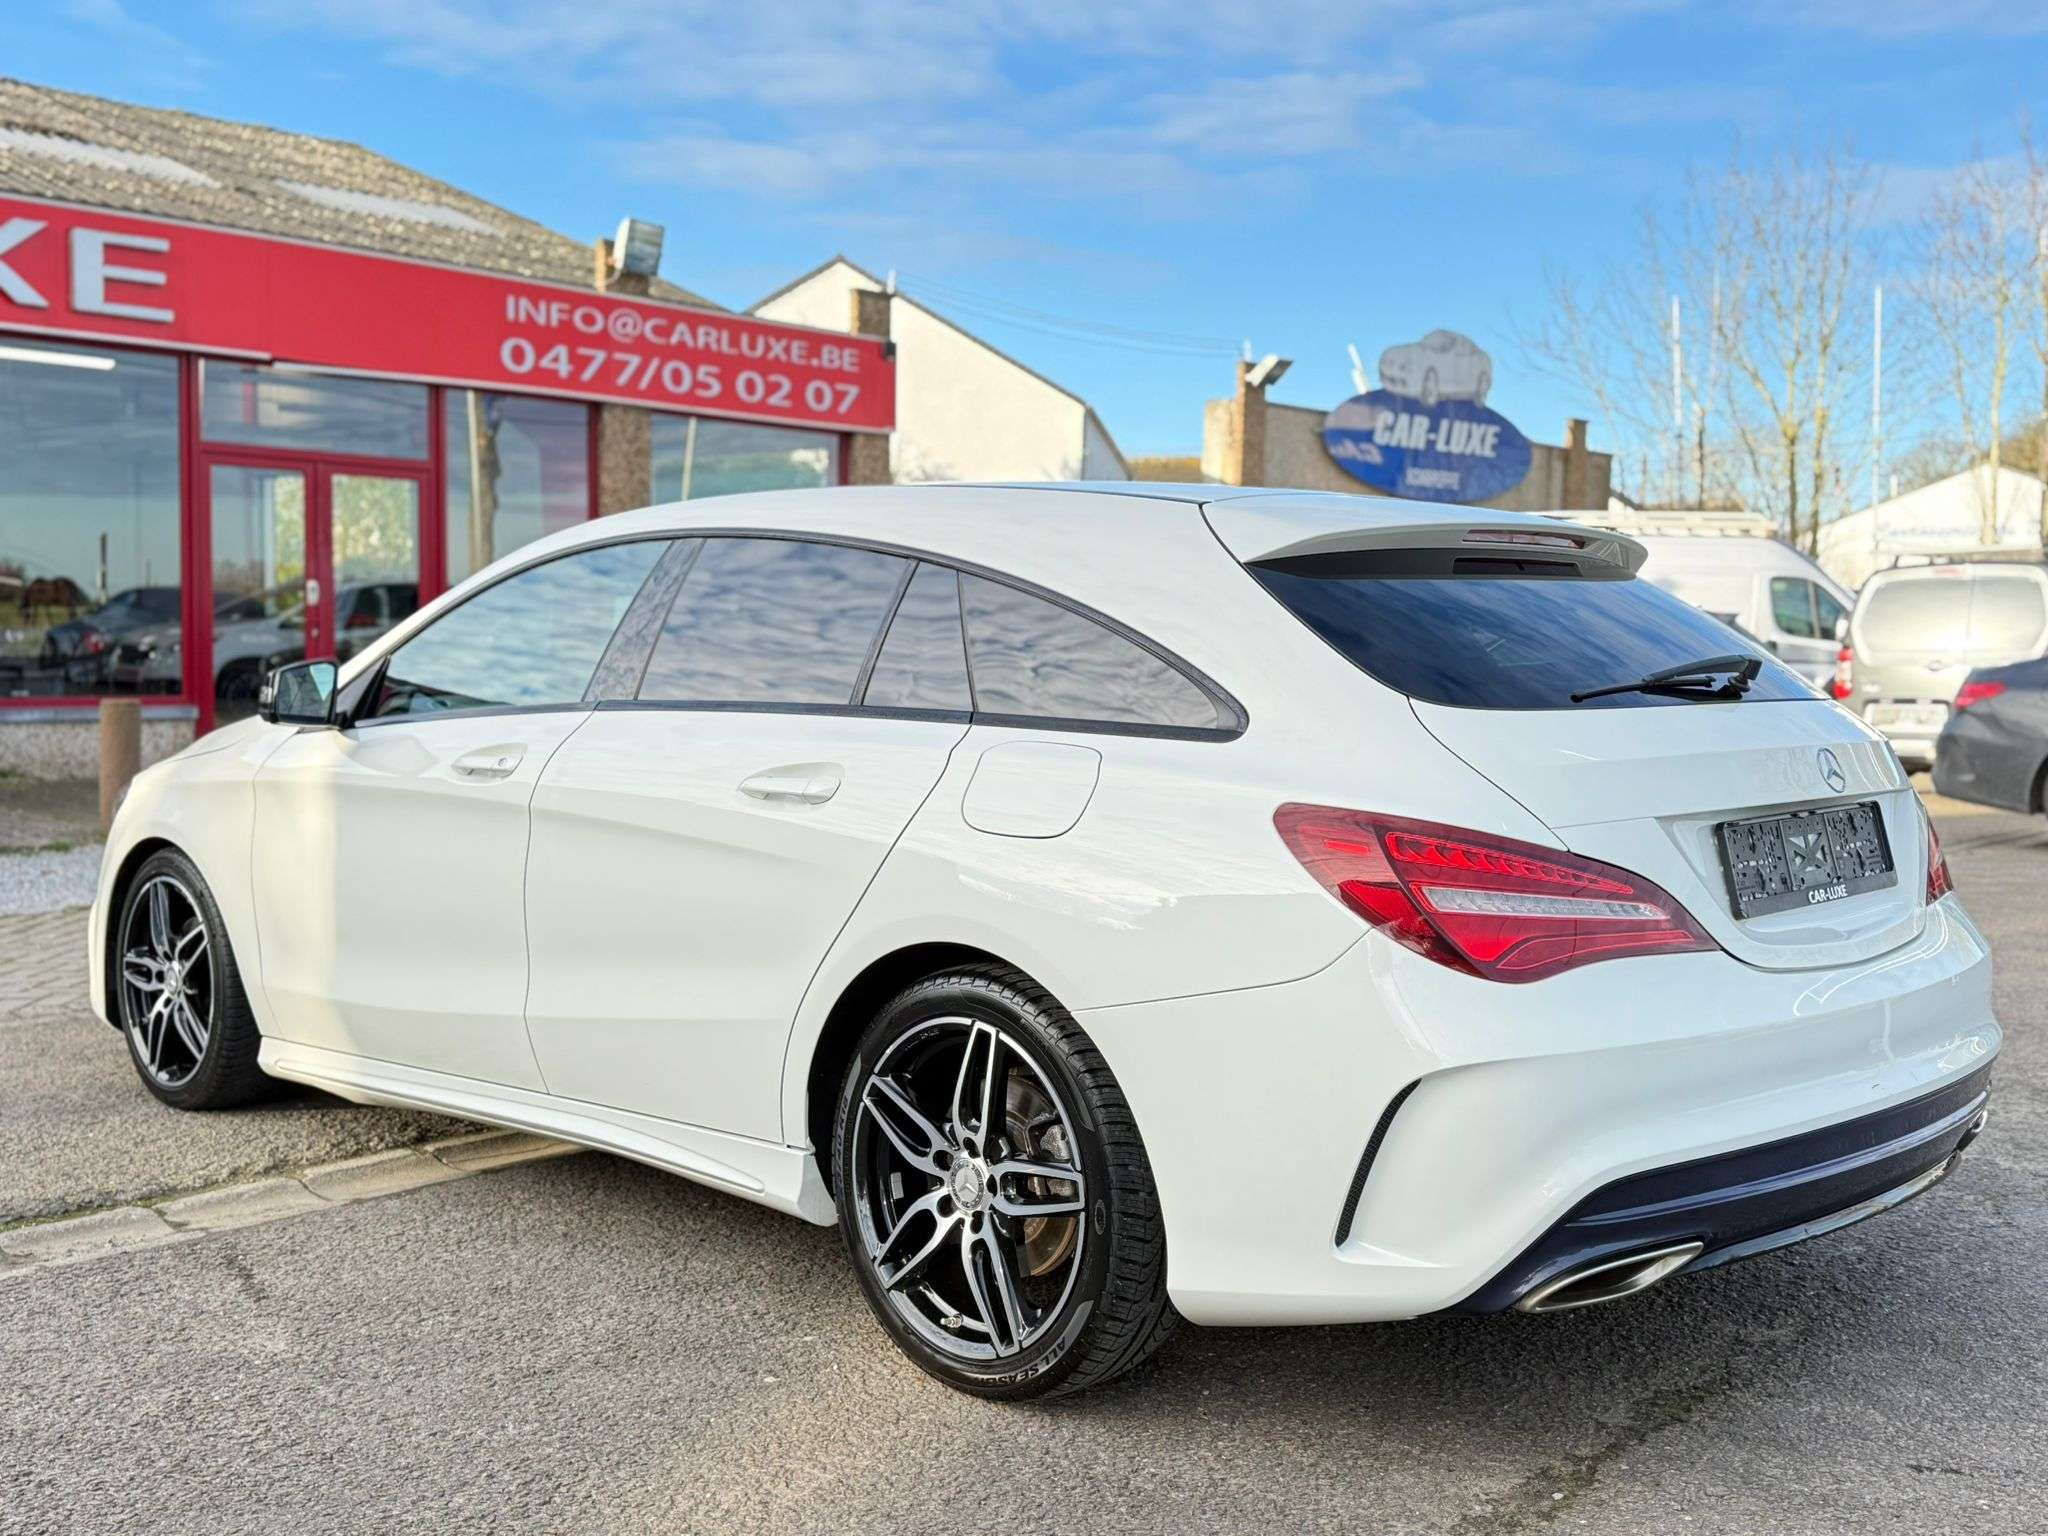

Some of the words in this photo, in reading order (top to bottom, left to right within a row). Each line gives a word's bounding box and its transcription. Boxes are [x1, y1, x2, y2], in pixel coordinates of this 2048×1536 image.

[505, 294, 861, 373] INFO@CARLUXE.BE
[500, 337, 723, 400] 0477/05
[735, 370, 793, 408] 02
[804, 379, 861, 415] 07
[1372, 410, 1501, 458] CAR-LUXE
[1808, 884, 1848, 904] CAR-LUXE
